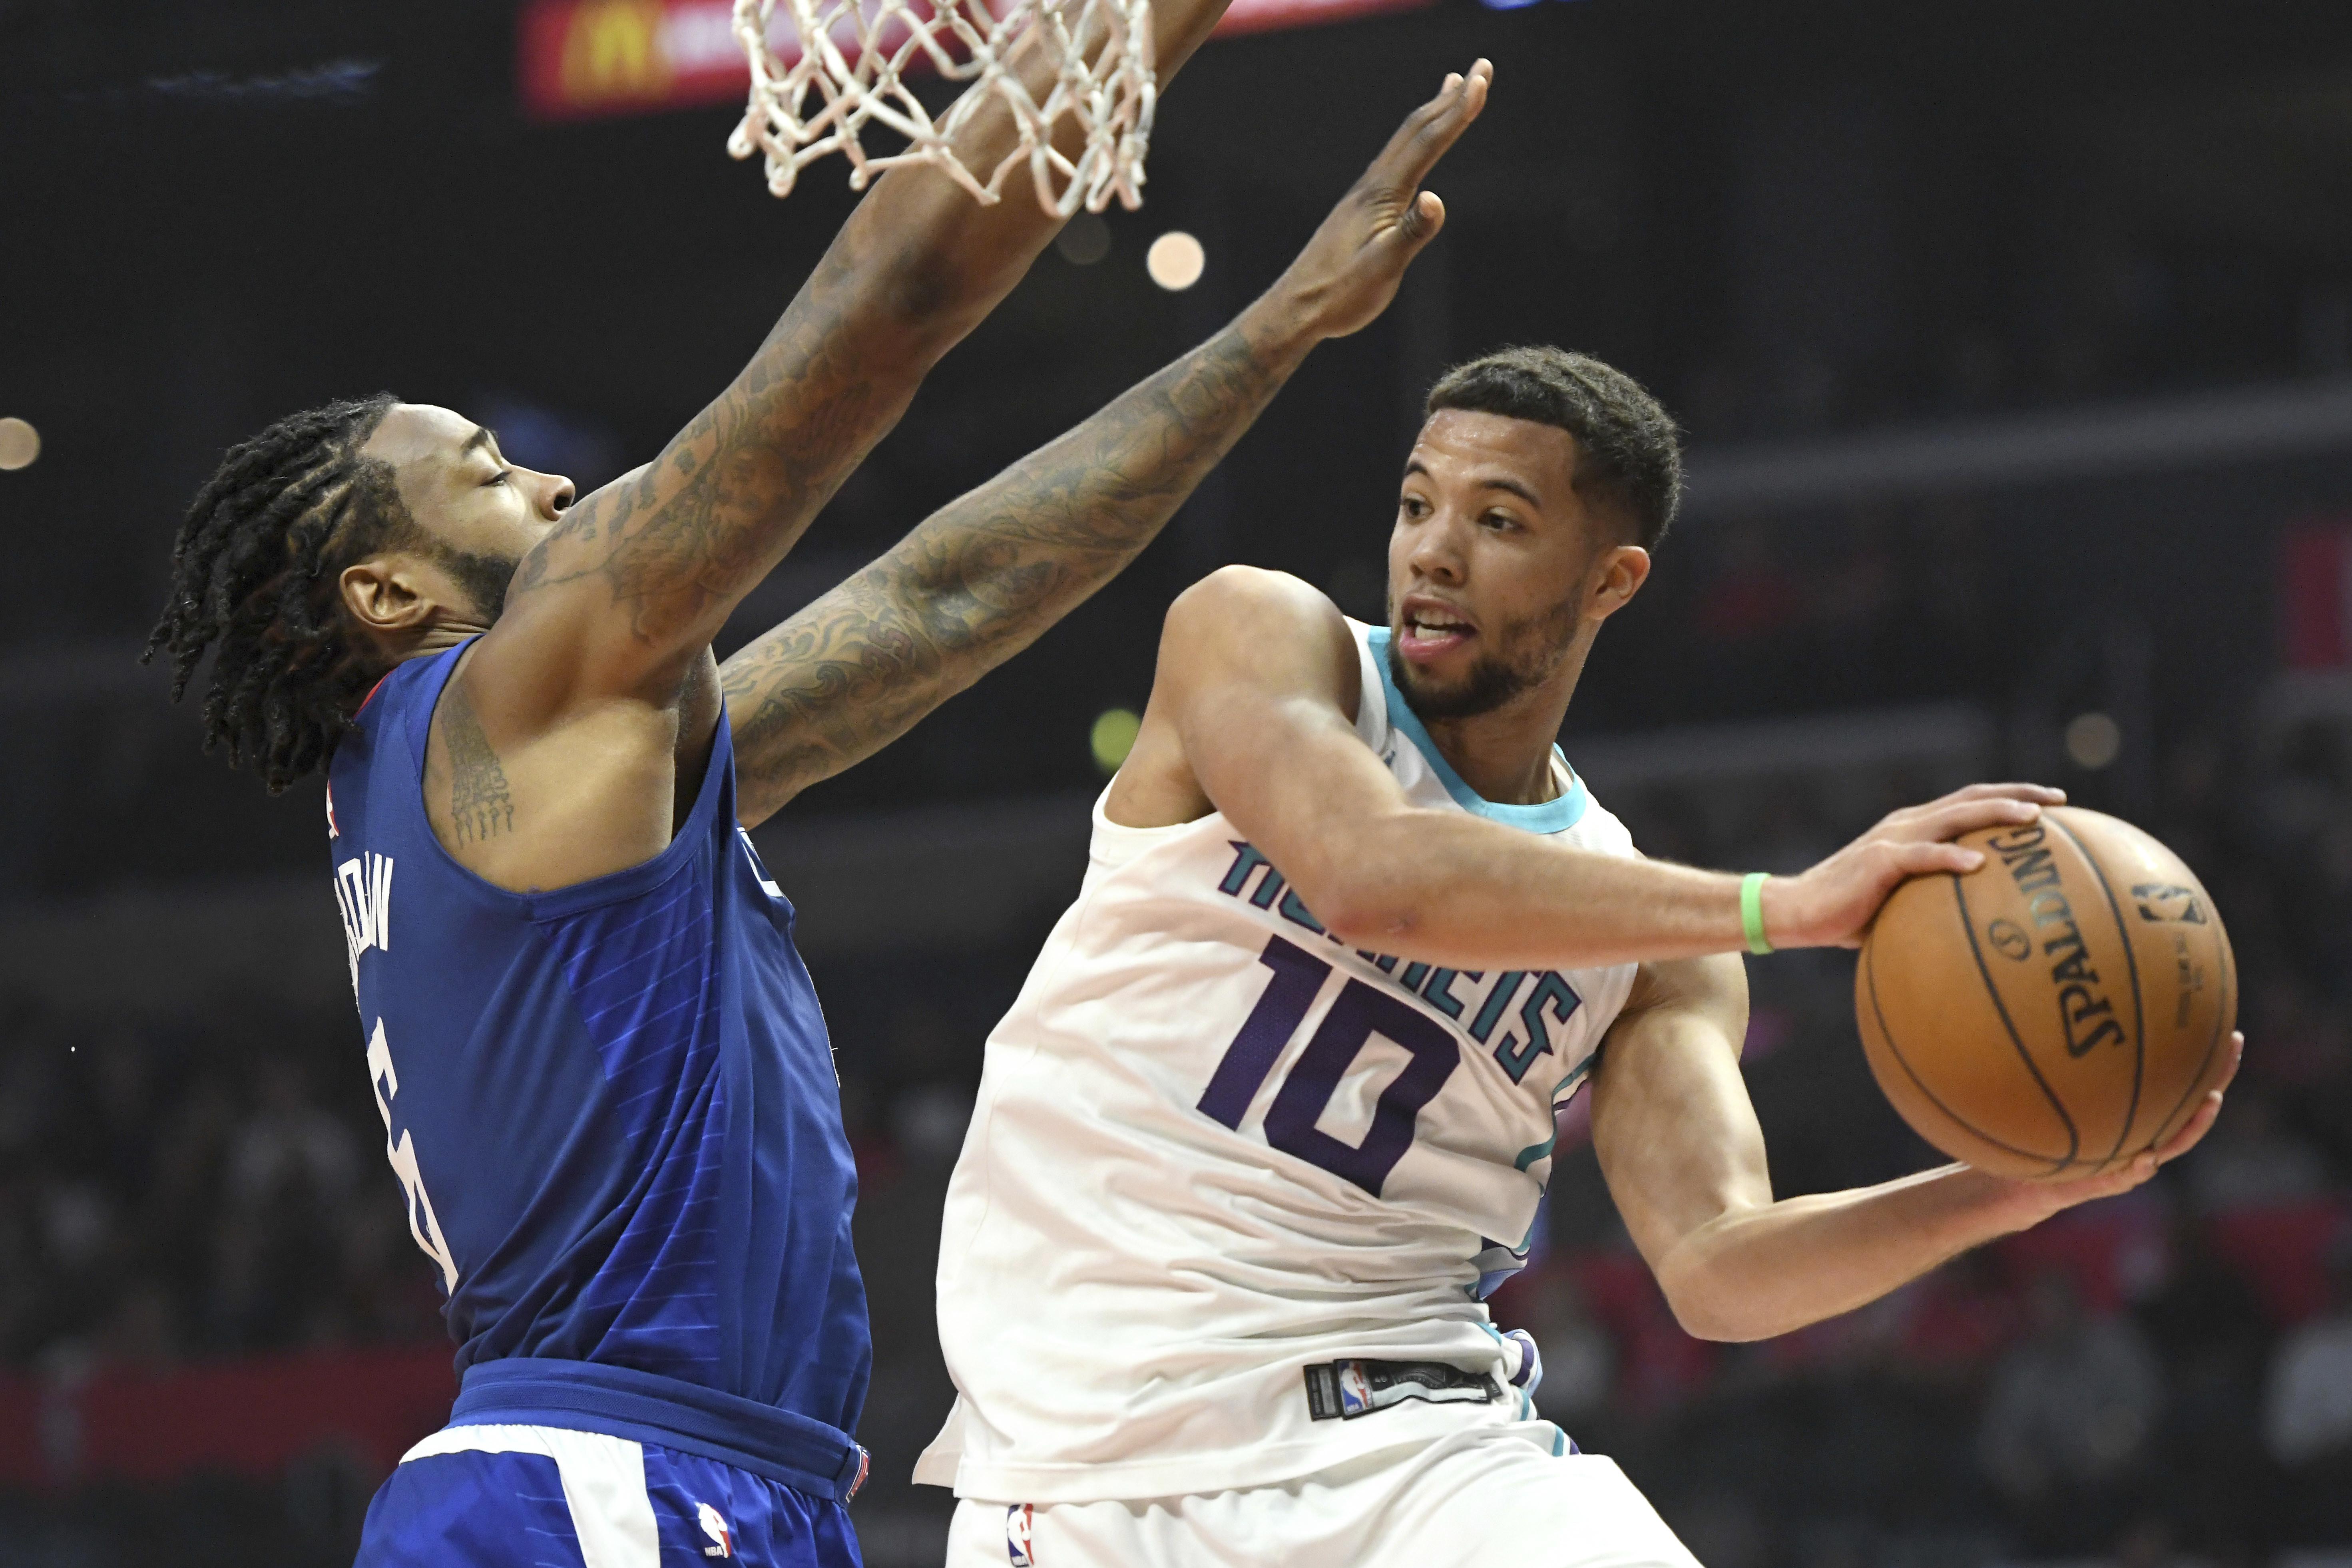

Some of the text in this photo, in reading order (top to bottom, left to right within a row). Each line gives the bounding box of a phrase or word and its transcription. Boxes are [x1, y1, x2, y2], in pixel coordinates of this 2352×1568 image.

[1988, 822, 2127, 1059] SPALDING
[1197, 933, 1461, 1199] 10
[705, 1546, 723, 1556] NBA
